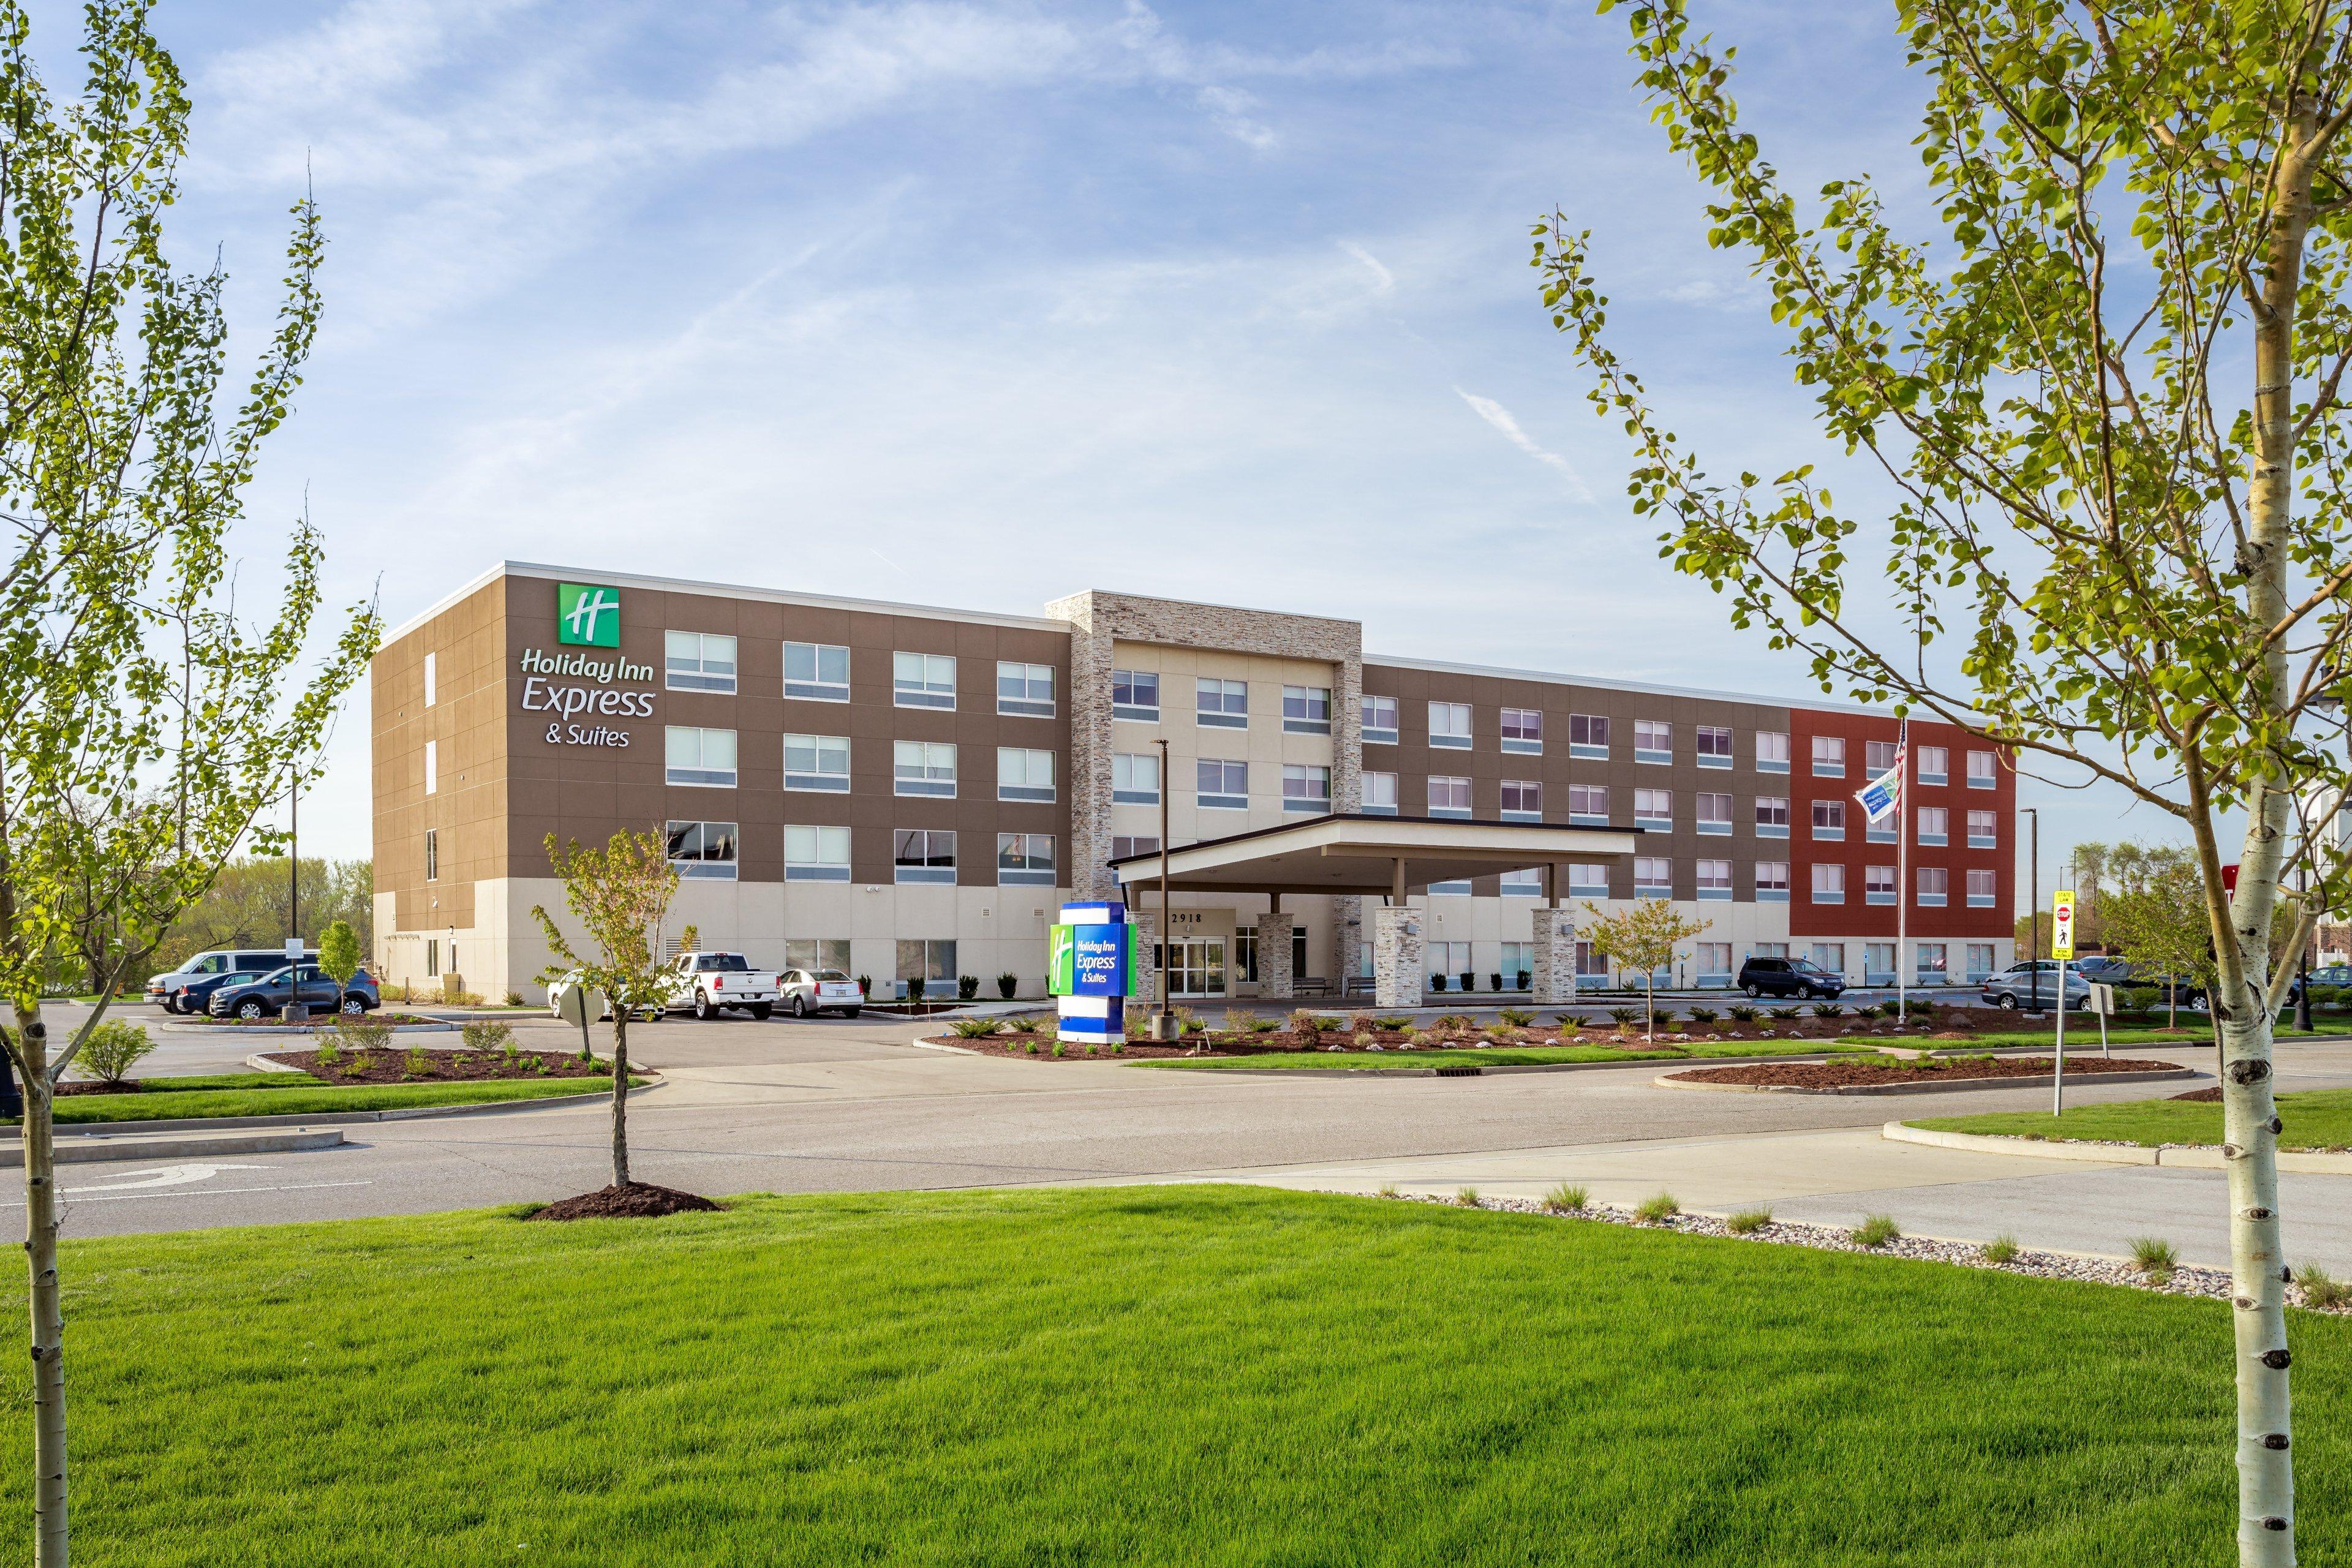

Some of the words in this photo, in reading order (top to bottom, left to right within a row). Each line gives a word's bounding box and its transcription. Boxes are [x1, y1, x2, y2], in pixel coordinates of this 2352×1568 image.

[520, 648, 614, 684] Holiday
[617, 656, 654, 681] Inn
[522, 677, 655, 721] Express
[546, 723, 562, 744] &
[566, 724, 630, 747] Suites
[1172, 913, 1201, 922] 2918
[1077, 940, 1102, 954] Holiday
[1102, 940, 1115, 951] Inn
[1077, 953, 1116, 973] Express
[1082, 973, 1087, 982] &
[1087, 973, 1107, 983] Suites
